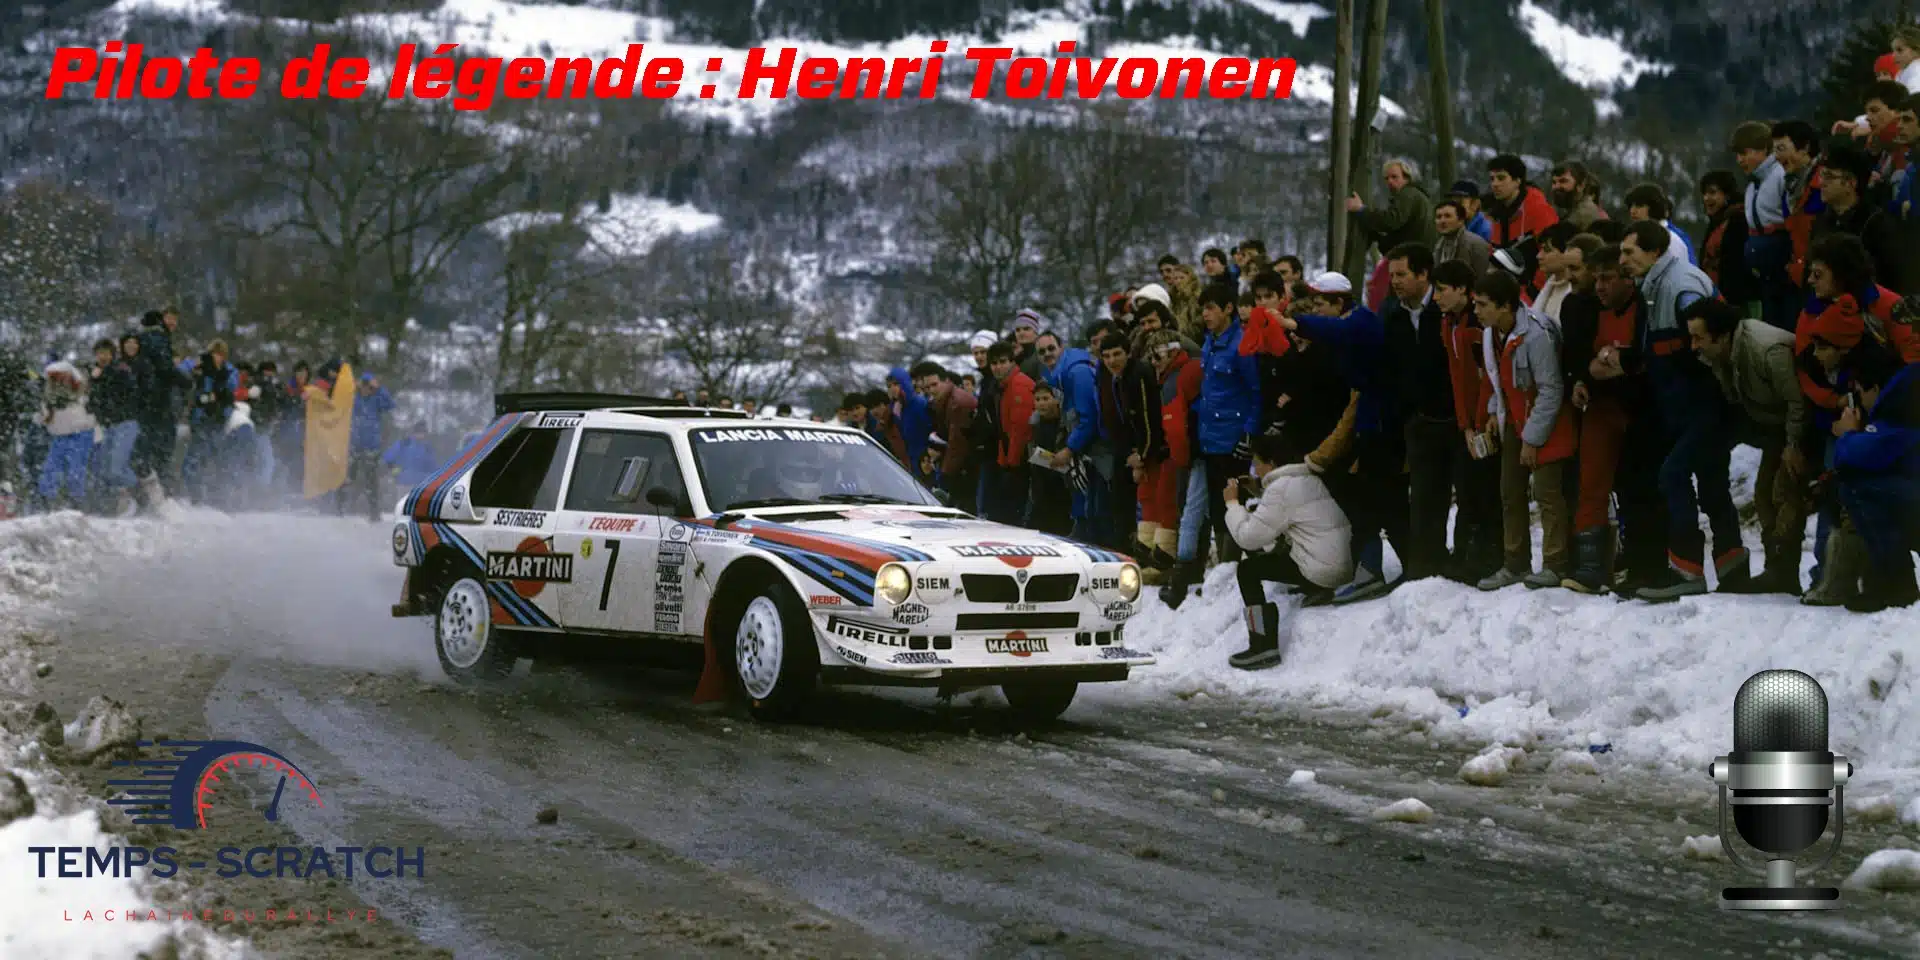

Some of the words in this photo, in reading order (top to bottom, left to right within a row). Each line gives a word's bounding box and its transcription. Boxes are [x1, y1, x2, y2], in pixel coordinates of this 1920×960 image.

[699, 429, 783, 443] LANCIA
[784, 430, 866, 446] MARTINI
[493, 509, 547, 529] SESTRIERES
[952, 546, 1058, 556] MARTINI
[488, 555, 571, 579] MARTINI
[599, 539, 620, 611] 7
[917, 577, 950, 590] SIEM
[1092, 578, 1119, 590] SIEM
[810, 595, 841, 605] WEBER
[827, 615, 909, 647] PIRELLI
[988, 639, 1048, 653] MARTINI
[846, 649, 868, 665] SIEM
